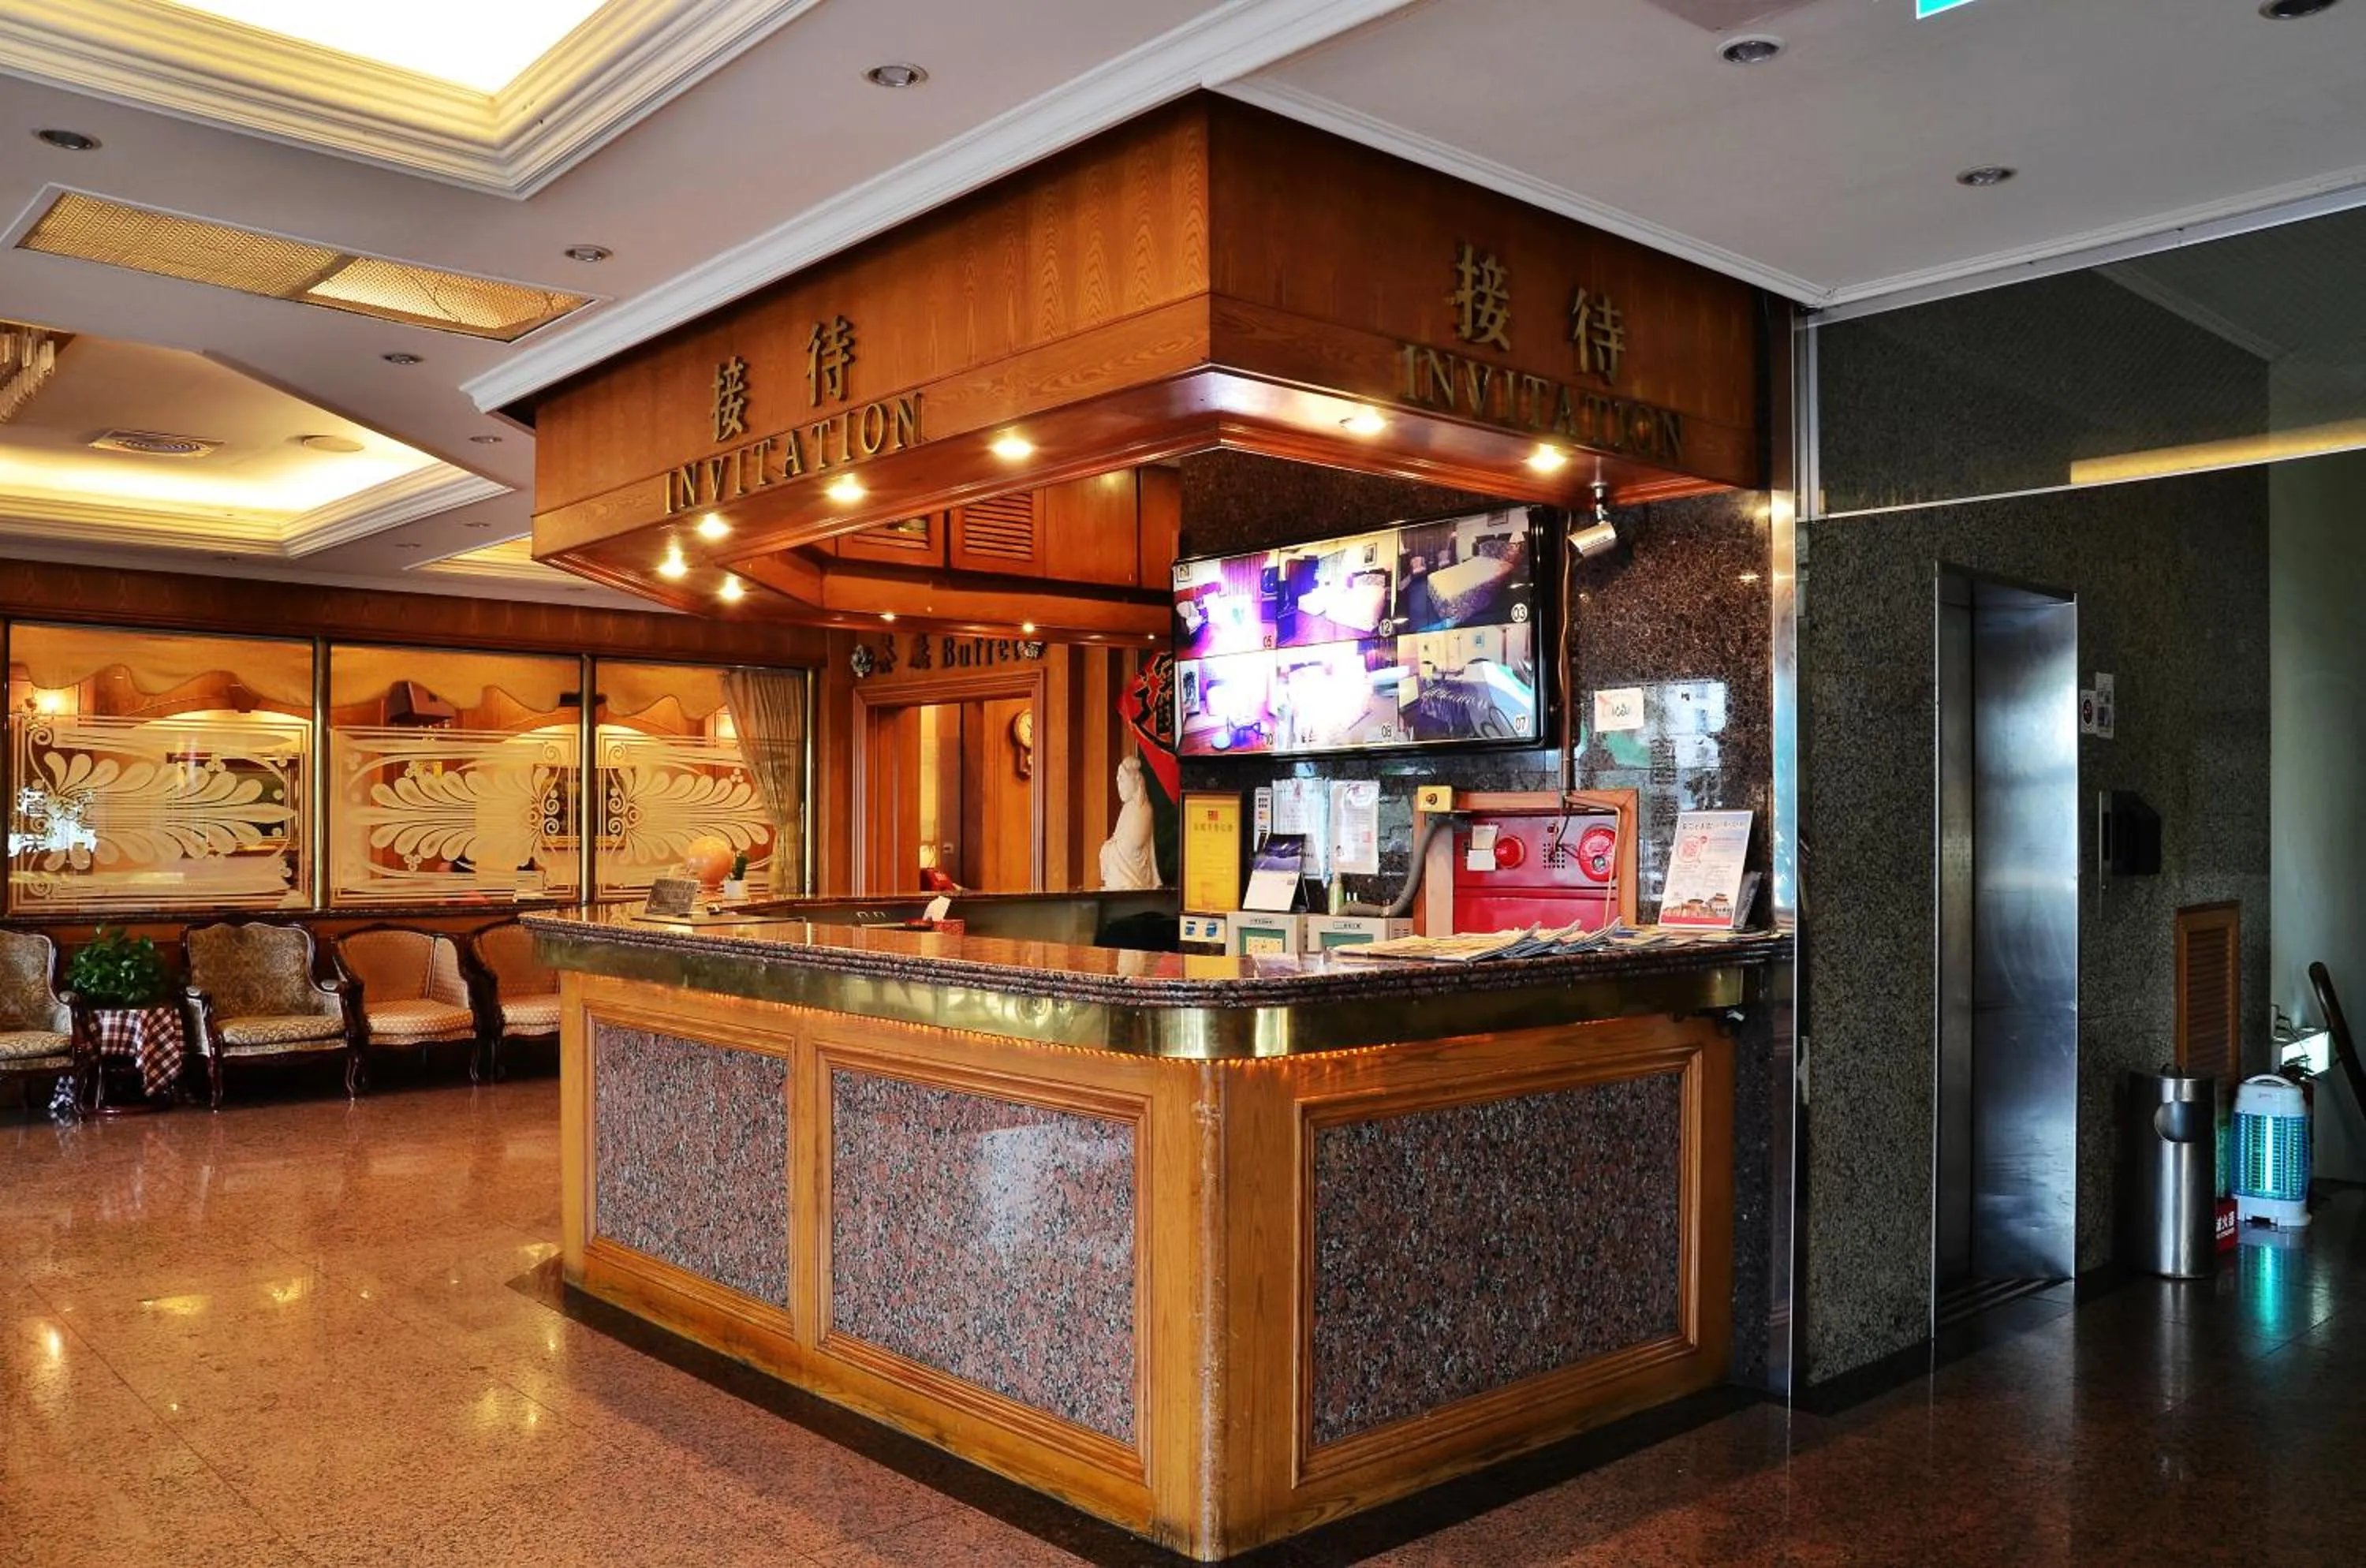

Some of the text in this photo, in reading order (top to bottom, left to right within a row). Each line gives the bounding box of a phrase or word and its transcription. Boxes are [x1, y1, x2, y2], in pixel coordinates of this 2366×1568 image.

[1454, 243, 1626, 384] 接待
[711, 315, 856, 442] 接待
[1401, 345, 1684, 458] INVITATION
[665, 393, 922, 514] INVITATION
[1515, 716, 1526, 731] 07
